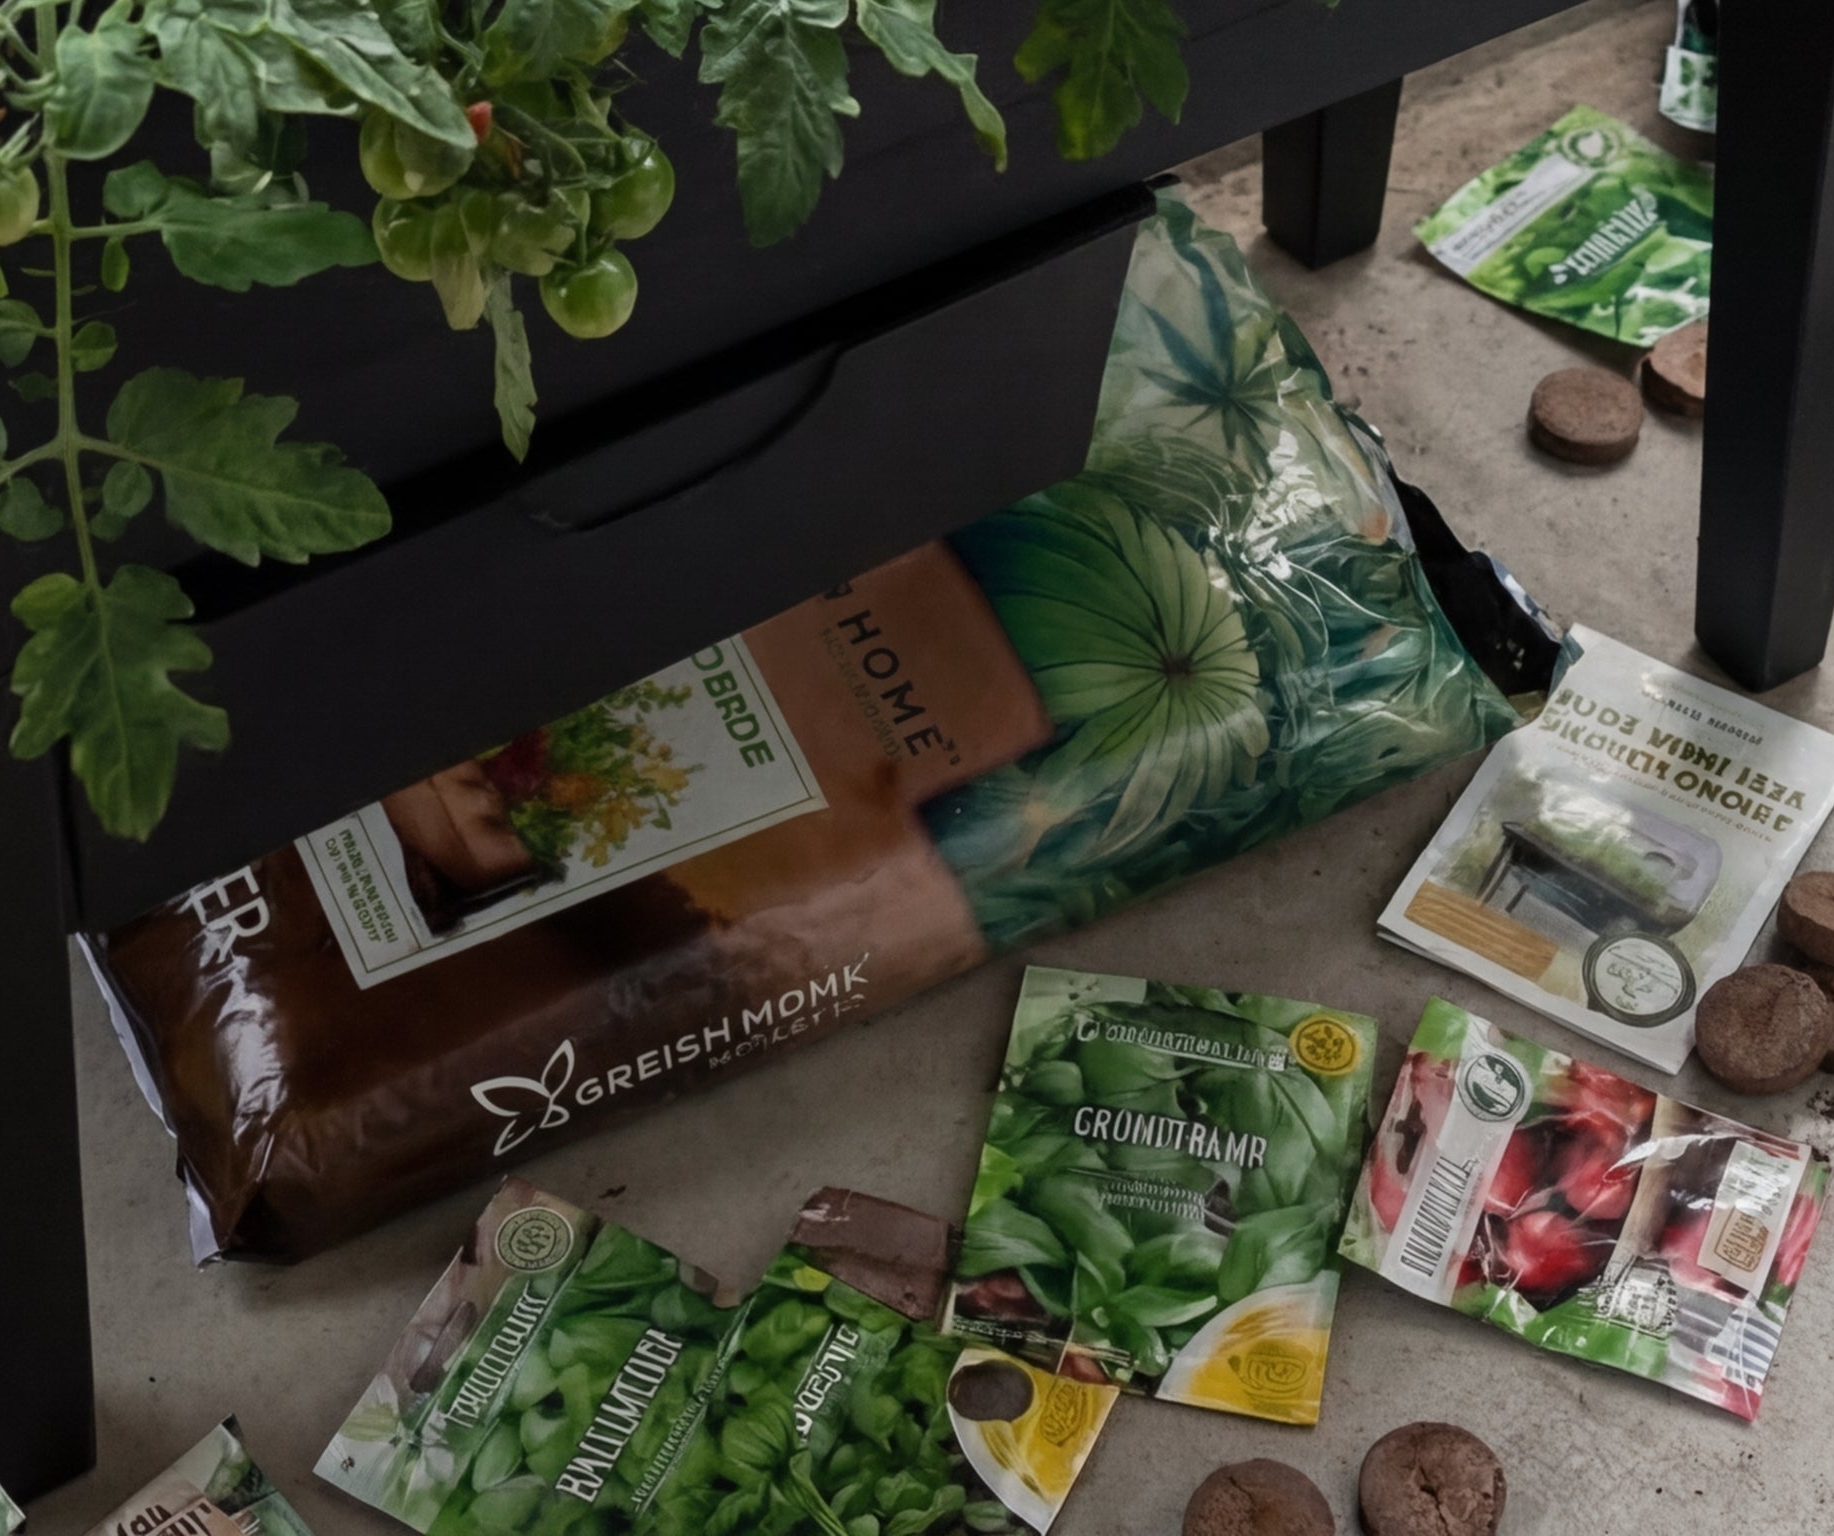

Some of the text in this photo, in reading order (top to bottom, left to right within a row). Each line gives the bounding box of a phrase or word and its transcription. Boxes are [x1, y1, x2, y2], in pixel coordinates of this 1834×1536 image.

[836, 608, 944, 758] HOME
[574, 1016, 732, 1107] GREISH
[741, 951, 870, 1036] MOMK
